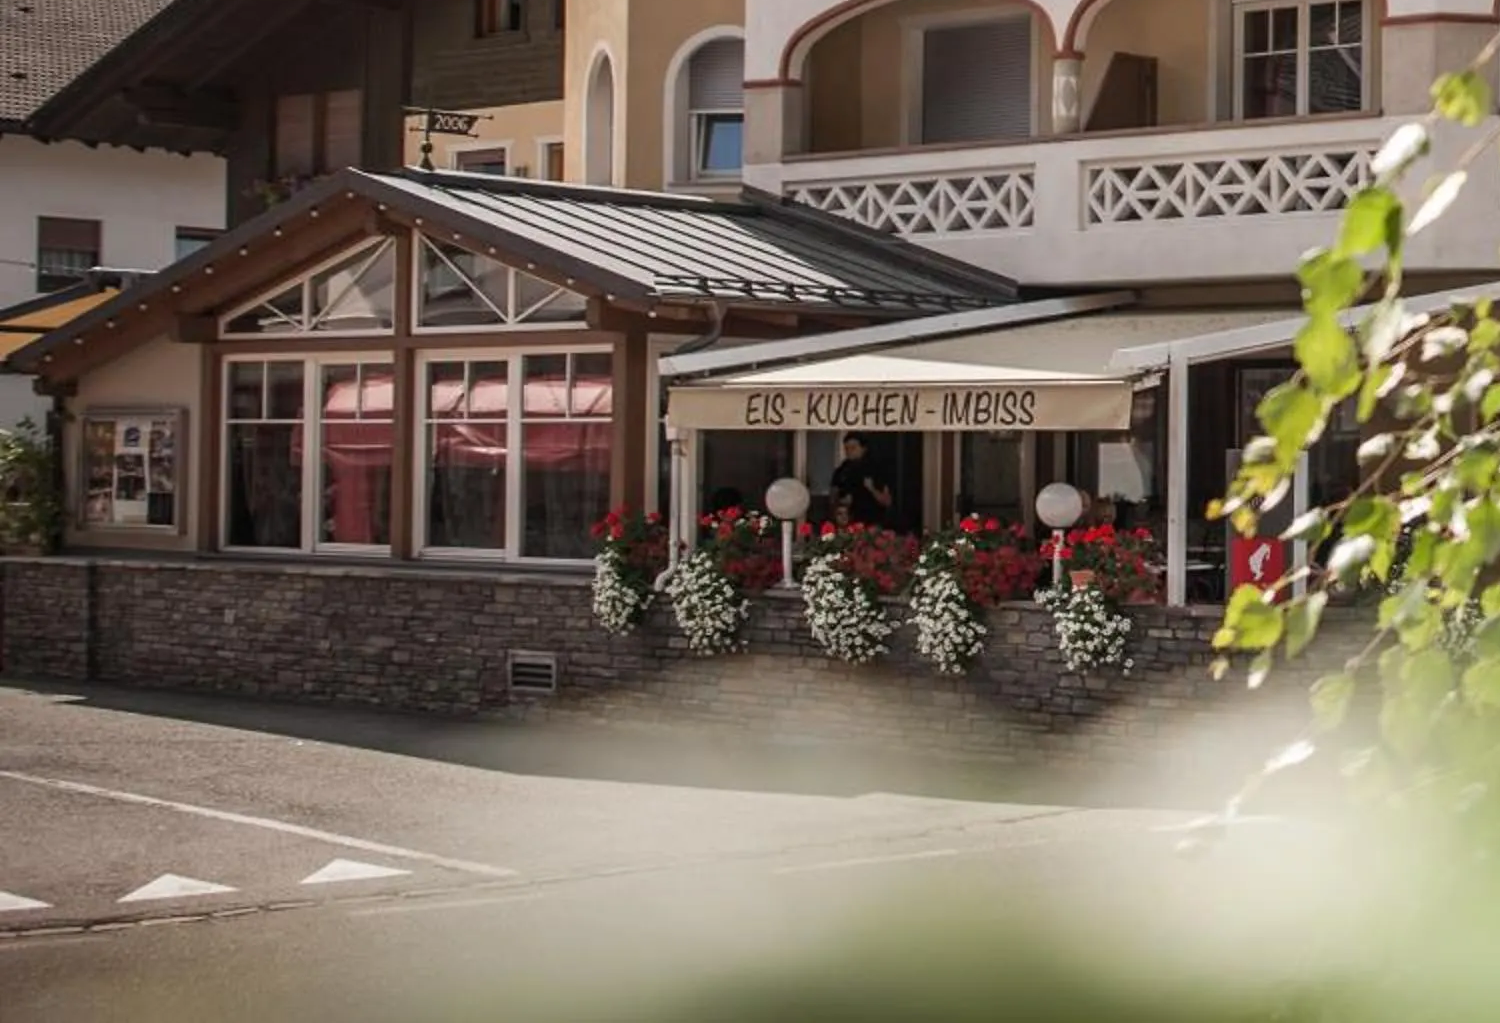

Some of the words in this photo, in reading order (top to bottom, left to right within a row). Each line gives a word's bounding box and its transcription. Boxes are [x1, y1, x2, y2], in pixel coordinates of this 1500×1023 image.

[745, 392, 785, 426] EIS
[807, 392, 919, 426] KUCHEN
[943, 390, 1035, 426] IMBISS
